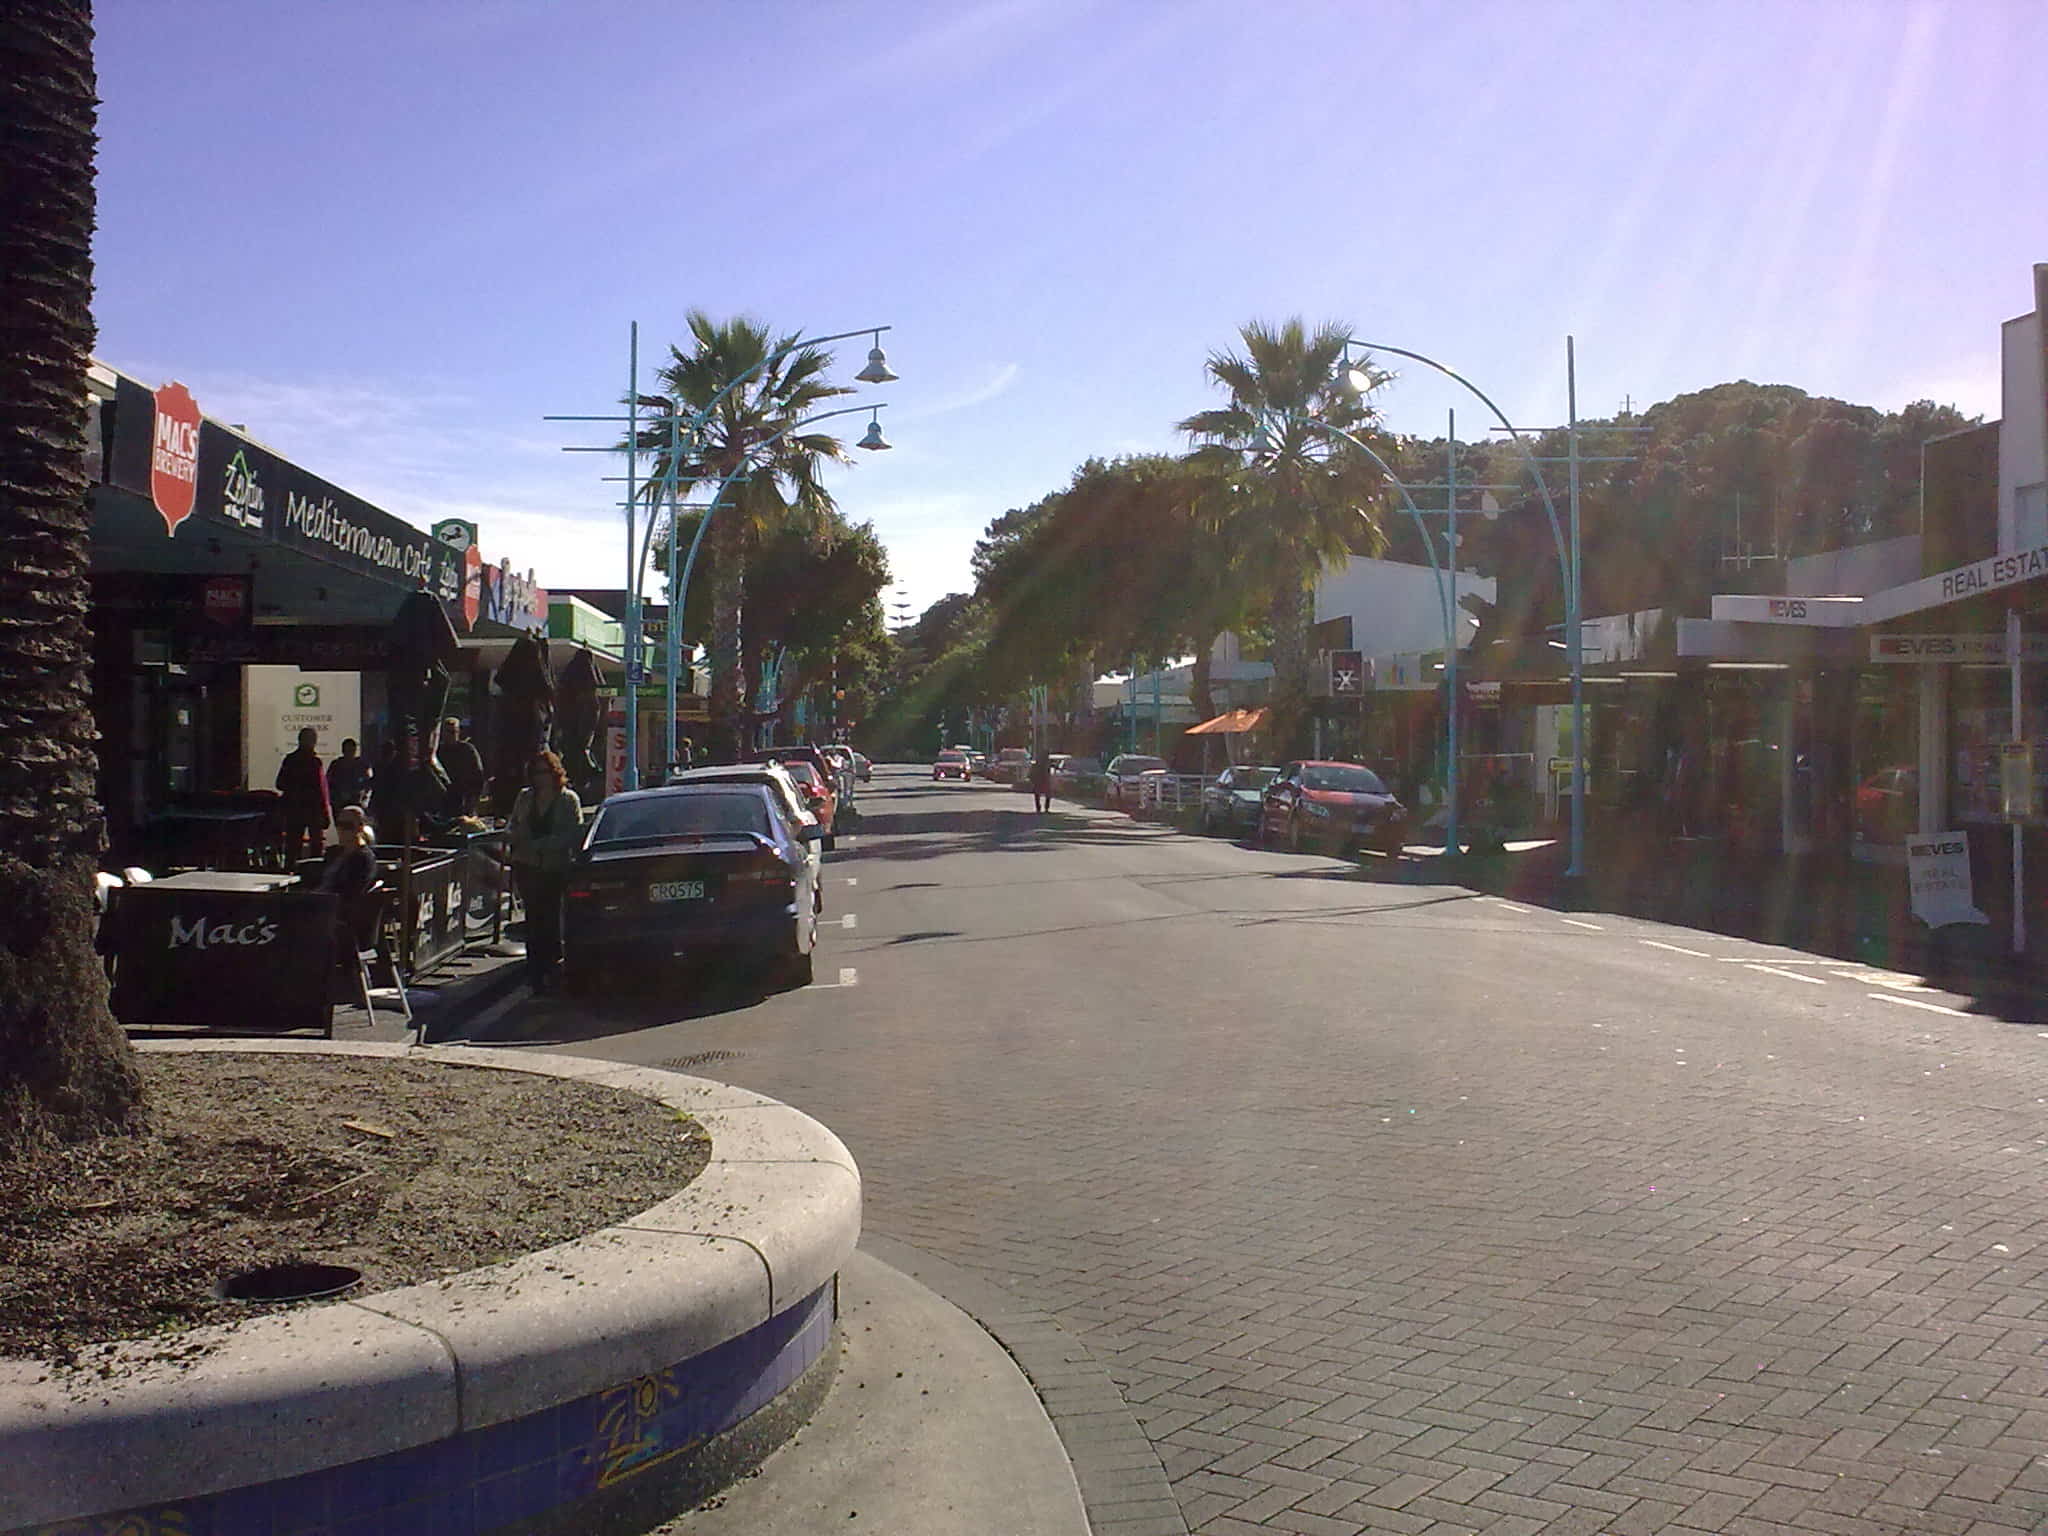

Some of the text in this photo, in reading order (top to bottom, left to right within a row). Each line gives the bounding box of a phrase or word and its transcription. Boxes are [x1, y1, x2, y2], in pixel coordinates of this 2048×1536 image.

[285, 491, 401, 569] Mediterranean
[1943, 567, 1988, 598] REAL
[1776, 601, 1807, 618] EVES
[1897, 639, 1955, 655] EVES
[168, 915, 278, 949] Mac's
